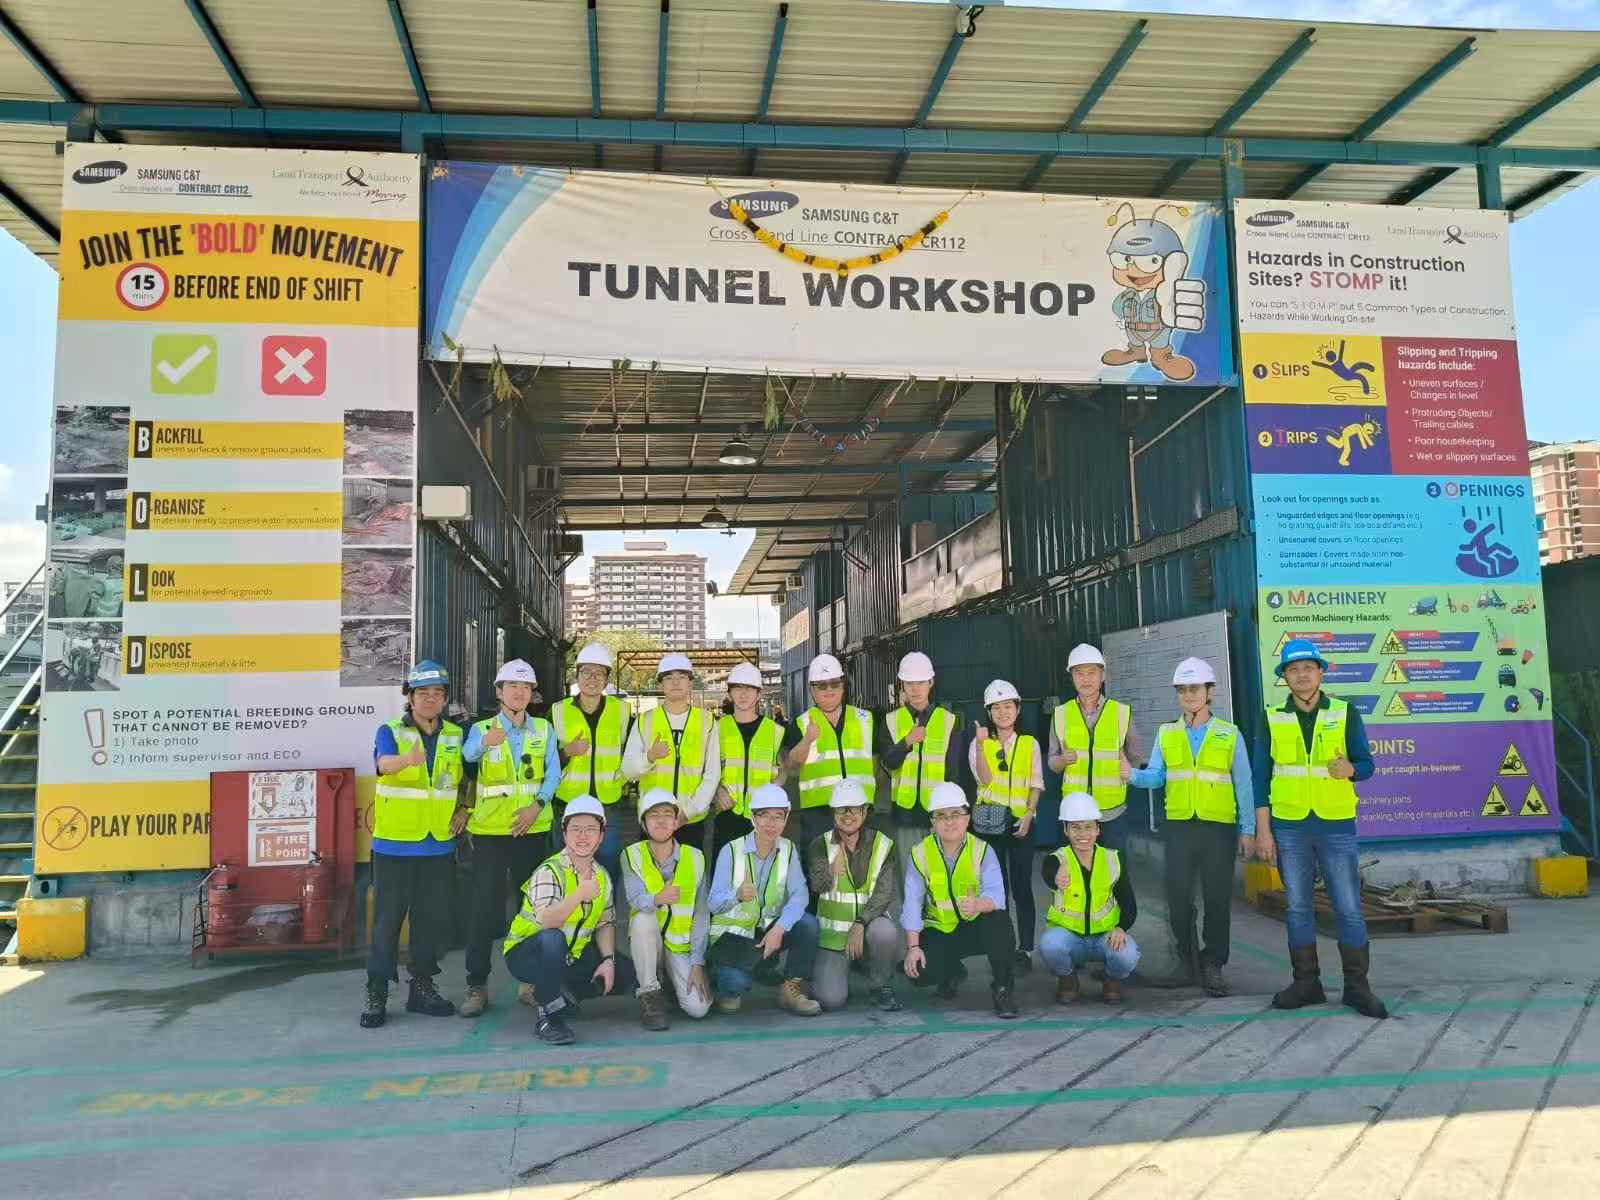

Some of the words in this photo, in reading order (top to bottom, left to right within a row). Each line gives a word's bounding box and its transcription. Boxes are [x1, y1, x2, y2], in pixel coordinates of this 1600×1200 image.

[79, 167, 121, 177] SAMSUNG
[137, 169, 181, 181] SAMSUNG
[184, 169, 200, 181] C&T
[178, 183, 222, 194] CONTRACT
[224, 185, 249, 194] CR112
[801, 207, 870, 224] SAMSUNG
[873, 211, 899, 225] C&T
[1296, 219, 1334, 229] SAMSUNG
[1336, 221, 1350, 230] C&T
[709, 226, 748, 240] Cross
[800, 226, 828, 243] Line
[834, 231, 912, 246] CONTRAC
[921, 236, 966, 250] CR112
[1307, 232, 1346, 240] CONTRACT
[79, 230, 133, 270] JOIN
[137, 224, 184, 258] THE
[190, 222, 265, 255] 'BOLD'
[271, 224, 404, 277] MOVEMENT
[1247, 250, 1322, 267] Hazards
[1328, 251, 1345, 268] in
[1350, 253, 1465, 273] Construction
[130, 274, 156, 291] 15
[1249, 271, 1303, 288] Sites?
[1310, 271, 1384, 291] STOMP
[1389, 275, 1407, 291] it!
[174, 275, 240, 300] BEFORE
[245, 276, 281, 301] END
[286, 277, 307, 301] OF
[313, 278, 363, 302] SHIFT
[568, 261, 786, 306] TUNNEL
[802, 270, 1096, 317] WORKSHOP
[1250, 300, 1268, 308] You
[1270, 301, 1288, 309] can
[1365, 303, 1408, 313] Common
[1410, 304, 1437, 315] Types
[1438, 304, 1447, 313] of
[1449, 305, 1505, 316] Construction
[1249, 312, 1285, 321] Hazards
[1311, 313, 1345, 324] Working
[1398, 346, 1436, 359] Slipping
[1439, 347, 1456, 357] and
[1459, 348, 1498, 360] Tripping
[1271, 362, 1310, 377] SLIPS
[1398, 361, 1436, 371] hazards
[1409, 379, 1441, 388] Uneven
[1443, 379, 1477, 389] surfaces
[1410, 390, 1447, 402] Changes
[1458, 391, 1478, 400] level
[1411, 408, 1456, 419] Protruding
[1414, 420, 1444, 430] Trailing
[1446, 419, 1474, 429] cables
[1275, 430, 1318, 446] TRIPS
[1414, 436, 1435, 445] Poor
[1437, 436, 1495, 447] housekeeping
[1416, 452, 1432, 461] Wet
[1446, 452, 1478, 463] slippery
[1480, 452, 1516, 462] surfaces
[1444, 481, 1525, 498] OPENINGS
[1262, 495, 1281, 504] Look
[1299, 495, 1311, 503] for
[1313, 496, 1348, 505] openings
[1350, 495, 1369, 503] such
[1277, 512, 1316, 521] Unguarded
[1317, 512, 1338, 520] edges
[1340, 511, 1353, 519] and
[1355, 511, 1372, 519] floor
[1373, 511, 1405, 520] openings
[1279, 536, 1317, 544] Unsecured
[1279, 551, 1318, 559] Barricades
[1323, 551, 1349, 559] Covers
[1280, 560, 1319, 569] substantial
[1362, 560, 1392, 568] material
[1288, 591, 1387, 606] MACHINERY
[1272, 614, 1311, 623] Common
[1312, 613, 1354, 624] Machinery
[112, 710, 148, 720] SPOT
[153, 710, 161, 720] A
[167, 708, 242, 720] POTENTIAL
[246, 706, 314, 718] BREEDING
[319, 705, 375, 716] GROUND
[112, 722, 147, 733] THAT
[152, 721, 208, 733] CANNOT
[213, 721, 231, 731] BE
[235, 719, 308, 731] REMOVED?
[113, 737, 125, 748] 1)
[131, 736, 160, 747] Take
[164, 736, 199, 749] photo
[1368, 738, 1416, 755] OINTS
[112, 754, 125, 765] 2)
[129, 752, 168, 763] Inform
[173, 751, 242, 764] supervisor
[246, 750, 270, 761] and
[273, 749, 301, 760] ECO
[1381, 765, 1393, 775] get
[1394, 764, 1420, 775] caught
[90, 815, 132, 838] PLAY
[136, 813, 177, 836] YOUR
[183, 812, 212, 835] PAR
[276, 834, 308, 845] FIRE
[276, 848, 308, 858] POINT
